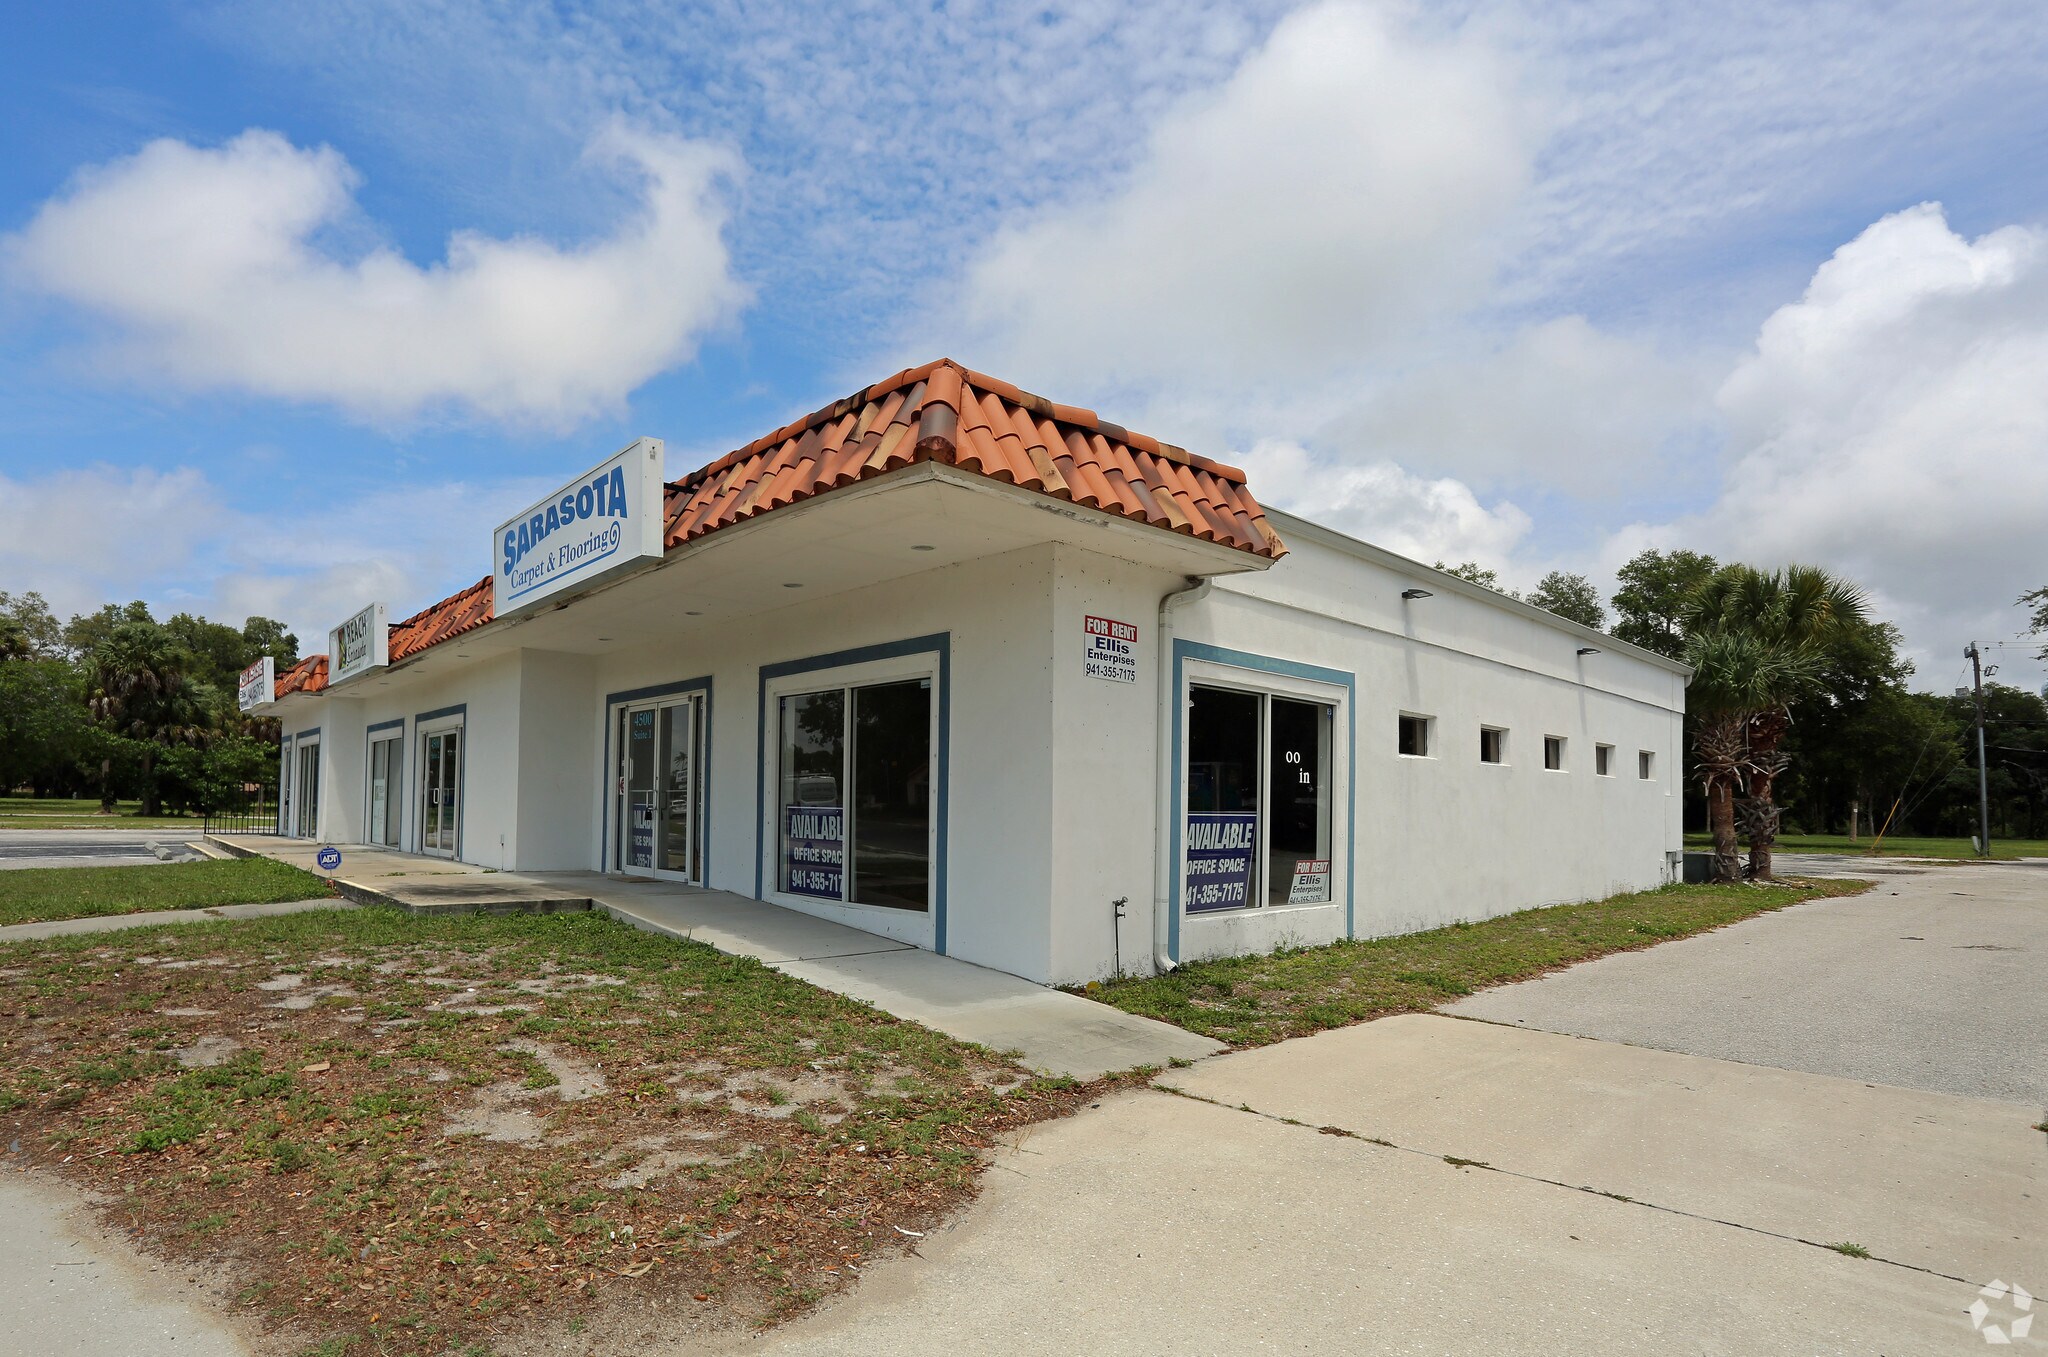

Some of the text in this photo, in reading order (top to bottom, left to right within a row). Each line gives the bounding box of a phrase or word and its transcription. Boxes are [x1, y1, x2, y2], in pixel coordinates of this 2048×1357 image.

[504, 465, 628, 576] SARASOTA
[511, 529, 609, 589] Carpet & Flooring
[1087, 618, 1135, 640] FOR RENT
[1096, 636, 1129, 654] Ellis
[1087, 648, 1135, 666] Enterpises
[1086, 663, 1135, 681] 941-355-7175
[634, 711, 652, 726] 4500
[1299, 767, 1310, 784] in
[791, 814, 843, 841] AVAILABL
[1187, 823, 1254, 850] AVAILABLE
[322, 855, 338, 864] ADT
[793, 846, 842, 864] OFFICE SPAC
[1186, 857, 1246, 876] OFFICE SPACE
[1296, 861, 1329, 874] FOR RENT
[1299, 875, 1321, 885] Ellis
